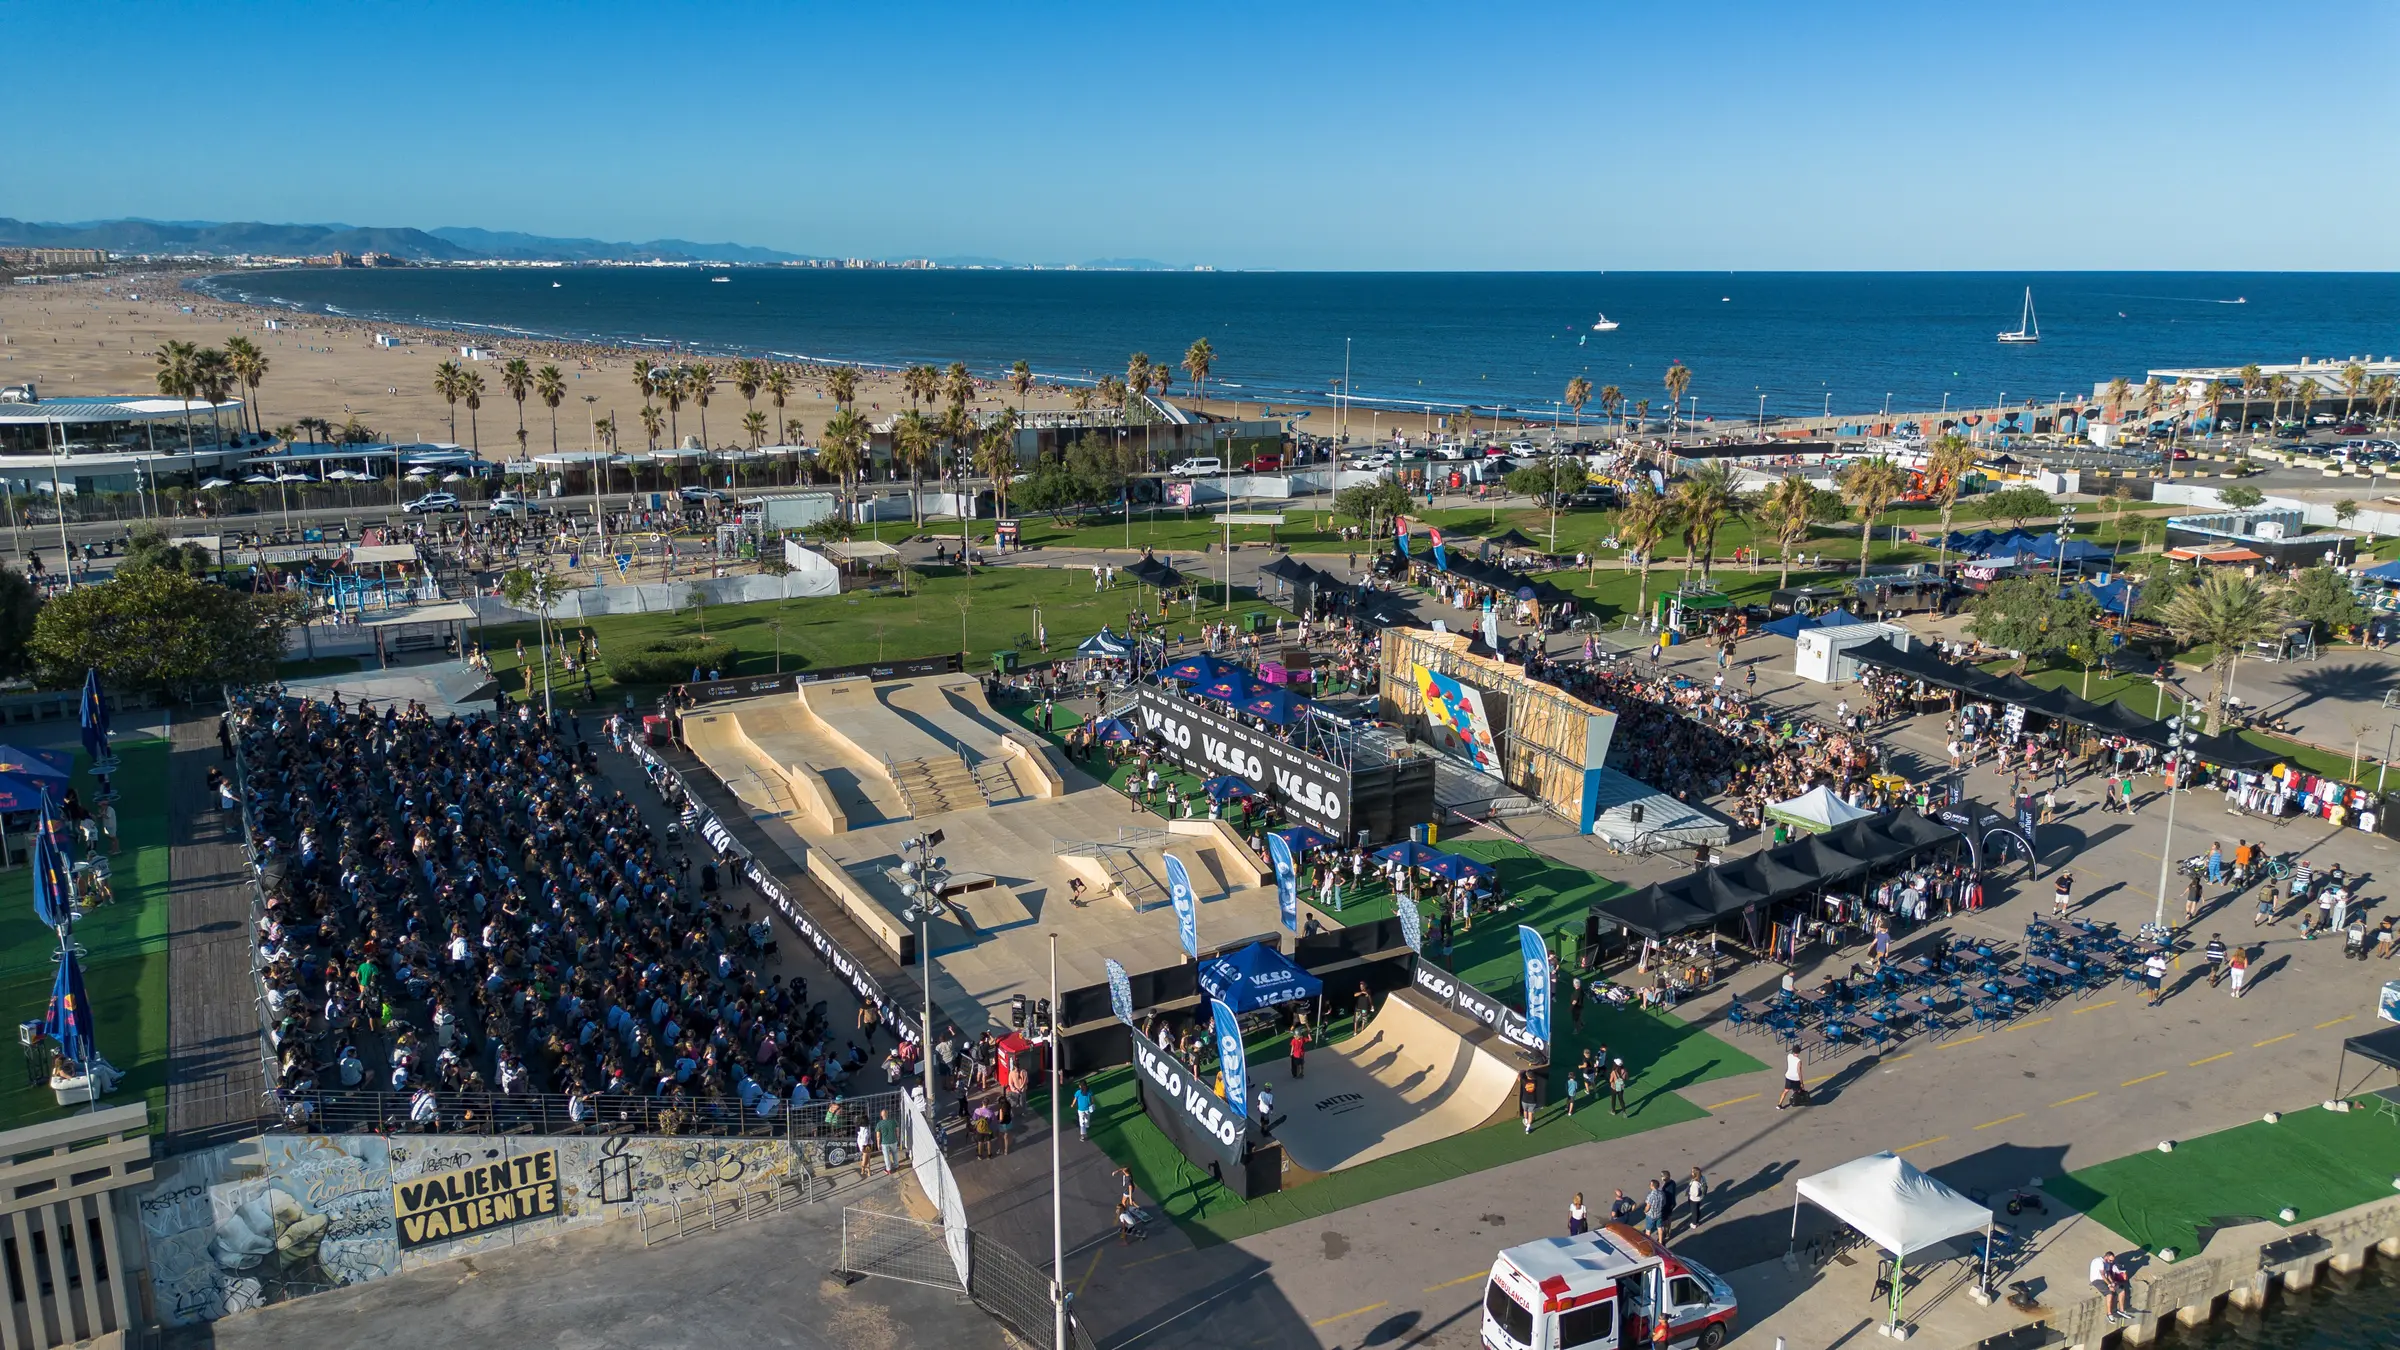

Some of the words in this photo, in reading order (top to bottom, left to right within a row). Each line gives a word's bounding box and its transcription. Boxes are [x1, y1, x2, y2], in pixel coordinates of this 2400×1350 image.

[1202, 733, 1263, 782] V.E.S.O
[1273, 766, 1340, 819] V.E.S.O
[1249, 970, 1292, 986] V.E.S.O
[1255, 987, 1306, 1007] V.E.S.O
[1417, 968, 1454, 998] V.E.S.O
[1459, 991, 1495, 1024] V.E.S.O
[1504, 1020, 1544, 1050] V.E.S.O
[1136, 1040, 1181, 1097] V.E.S.O
[1186, 1084, 1236, 1146] V.E.S.O
[401, 1151, 551, 1211] VALIENTE
[404, 1184, 555, 1242] VALIENTE
[1494, 1274, 1530, 1310] AMBULANCIA
